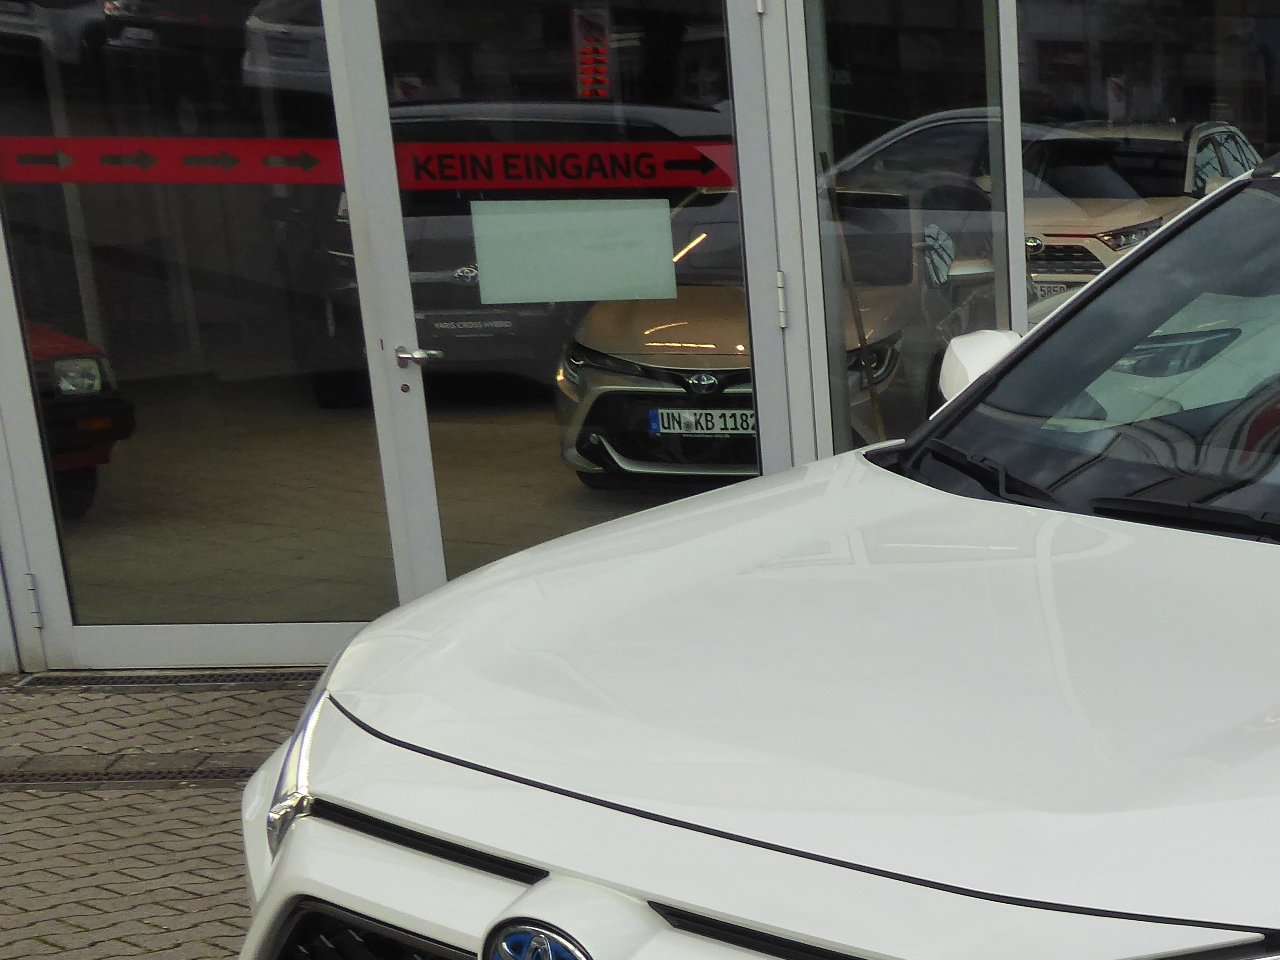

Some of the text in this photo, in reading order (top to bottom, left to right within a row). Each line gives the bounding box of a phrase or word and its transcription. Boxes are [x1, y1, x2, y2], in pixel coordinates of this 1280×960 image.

[412, 151, 657, 181] KEIN EINGANG
[660, 411, 682, 431] UN
[694, 412, 716, 431] KB
